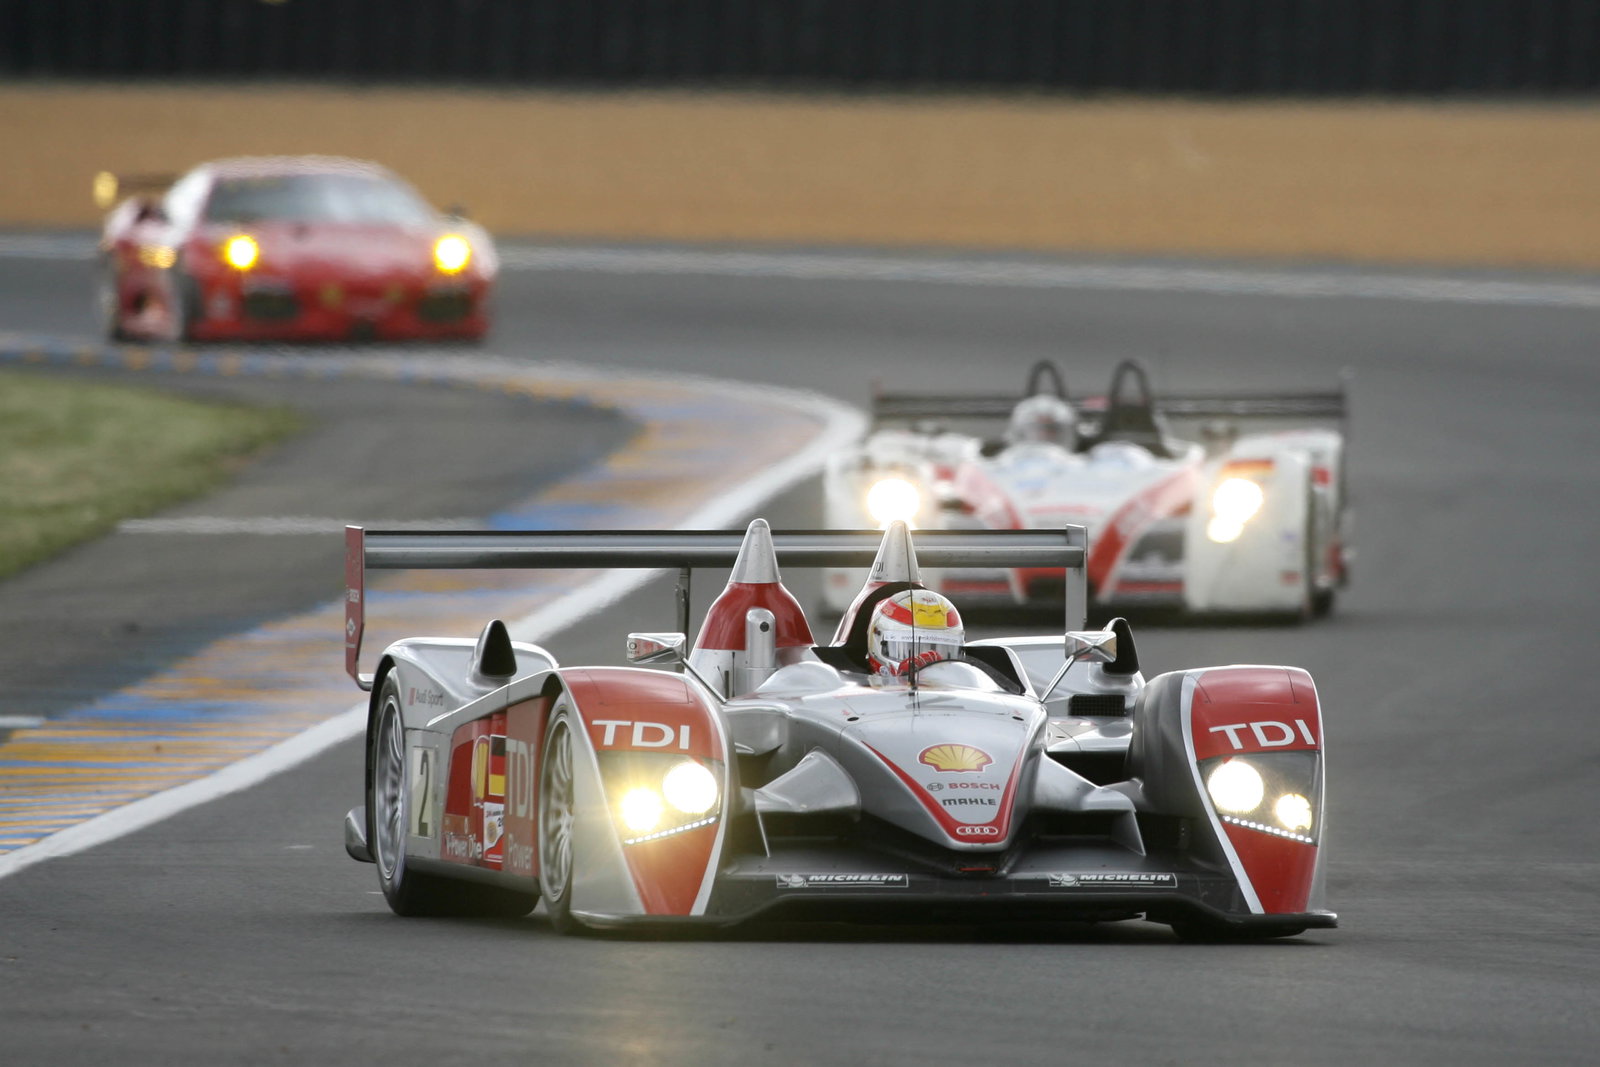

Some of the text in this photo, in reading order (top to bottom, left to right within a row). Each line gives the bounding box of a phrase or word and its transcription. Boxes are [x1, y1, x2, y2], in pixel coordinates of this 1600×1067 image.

[416, 688, 444, 708] Audi Sport
[592, 719, 690, 750] TDI
[1208, 719, 1316, 750] TDI
[505, 737, 535, 821] TDI
[948, 782, 1001, 790] BOSCH
[418, 749, 429, 837] 2
[942, 798, 997, 806] MAHLE
[507, 833, 534, 871] Power
[808, 874, 903, 882] MICHELIN
[1079, 873, 1171, 881] MICHELIN
